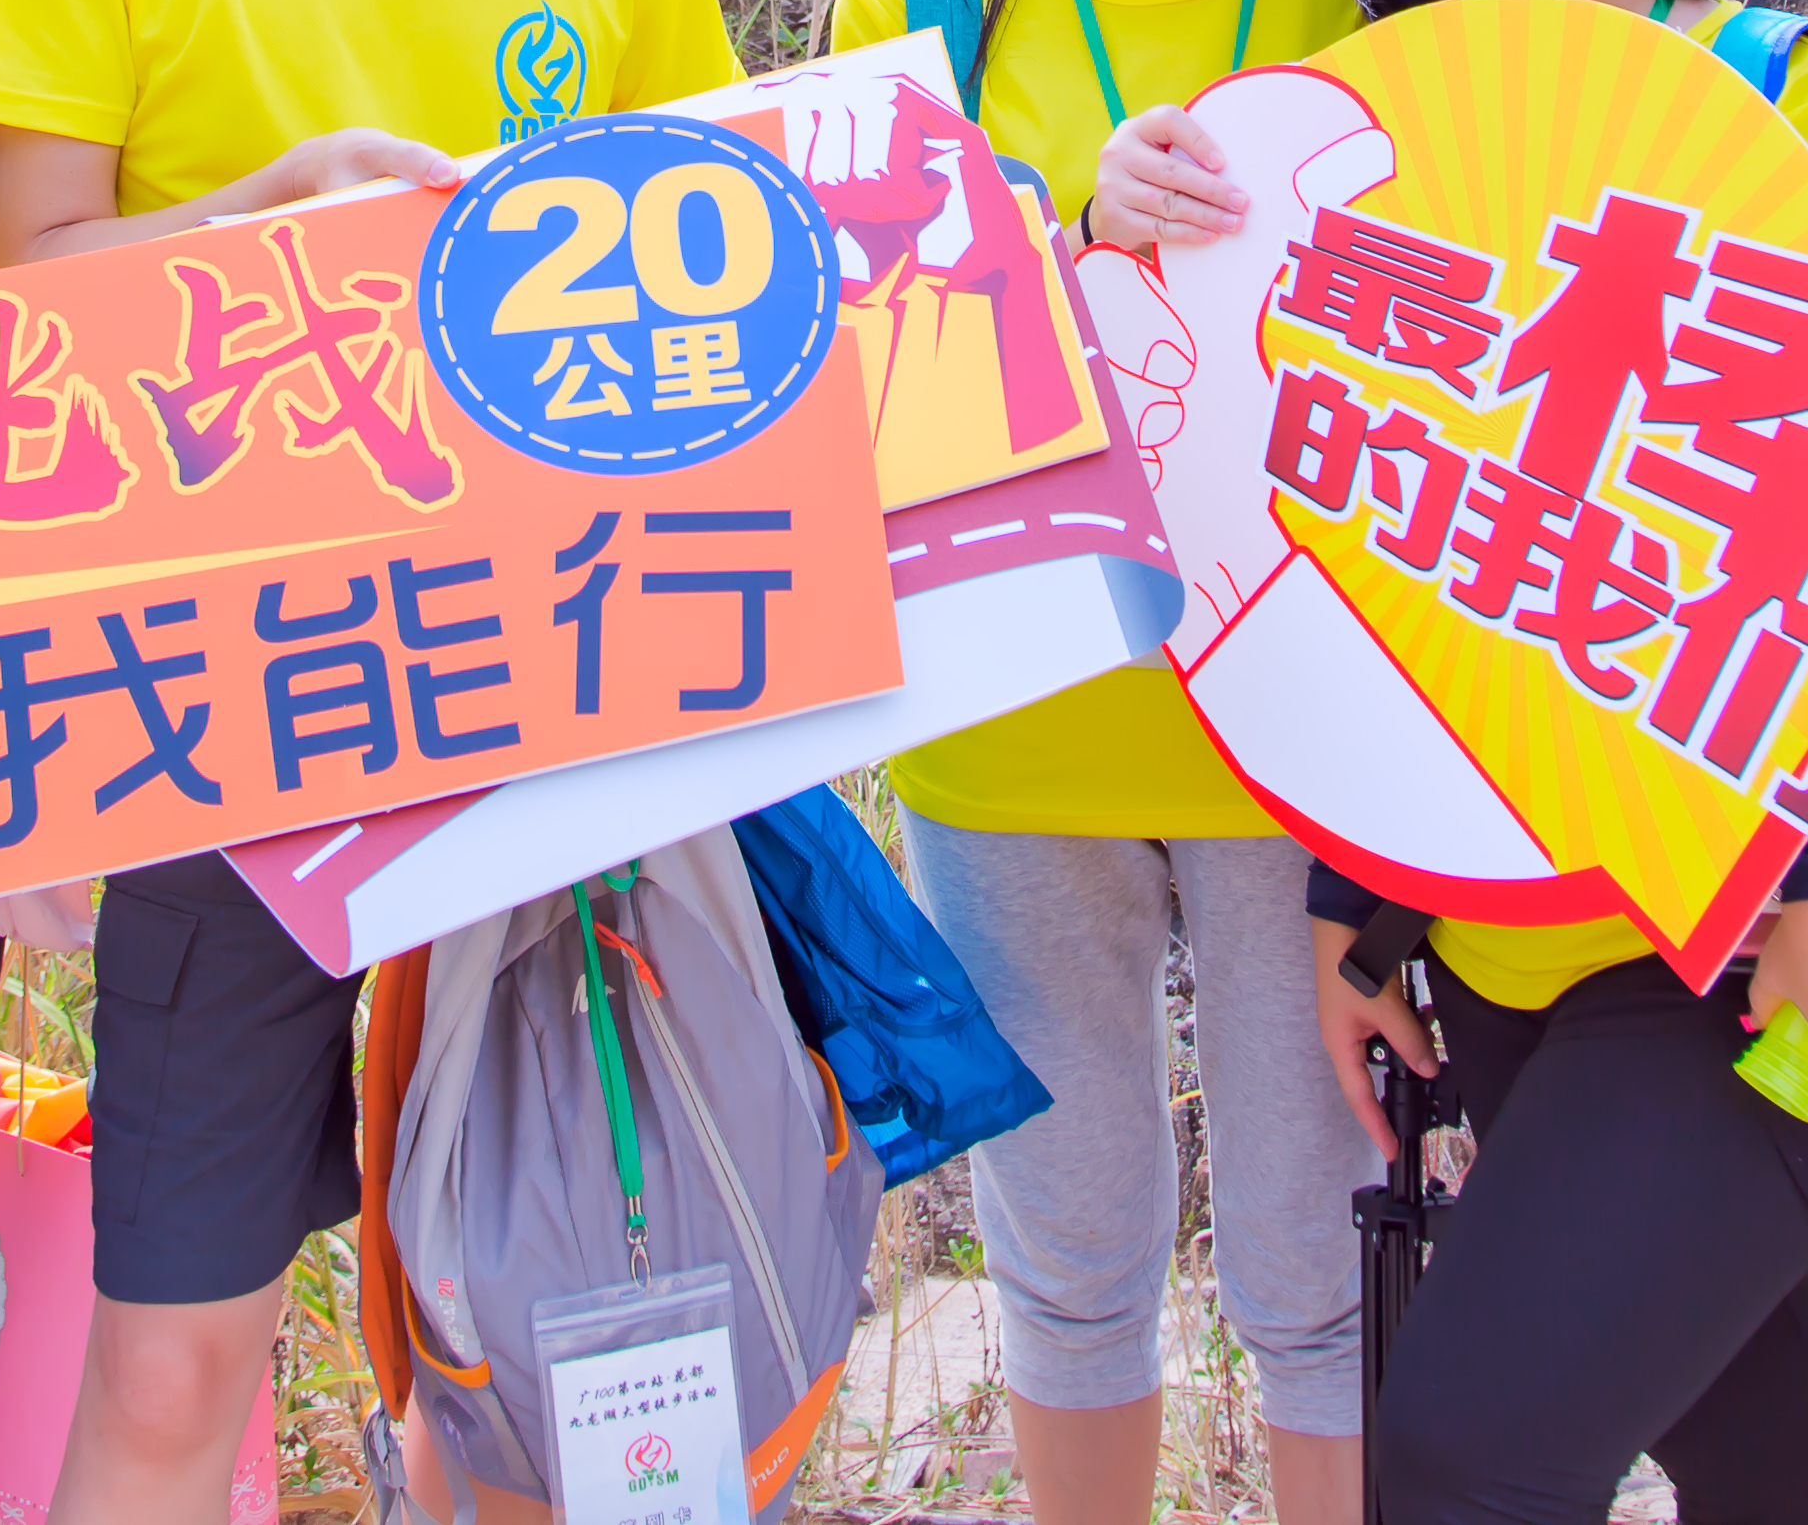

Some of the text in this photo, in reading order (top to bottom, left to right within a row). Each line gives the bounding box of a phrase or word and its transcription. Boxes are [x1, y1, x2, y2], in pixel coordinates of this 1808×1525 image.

[486, 162, 775, 336] 20
[533, 320, 753, 421] 公里
[438, 1278, 454, 1297] 20
